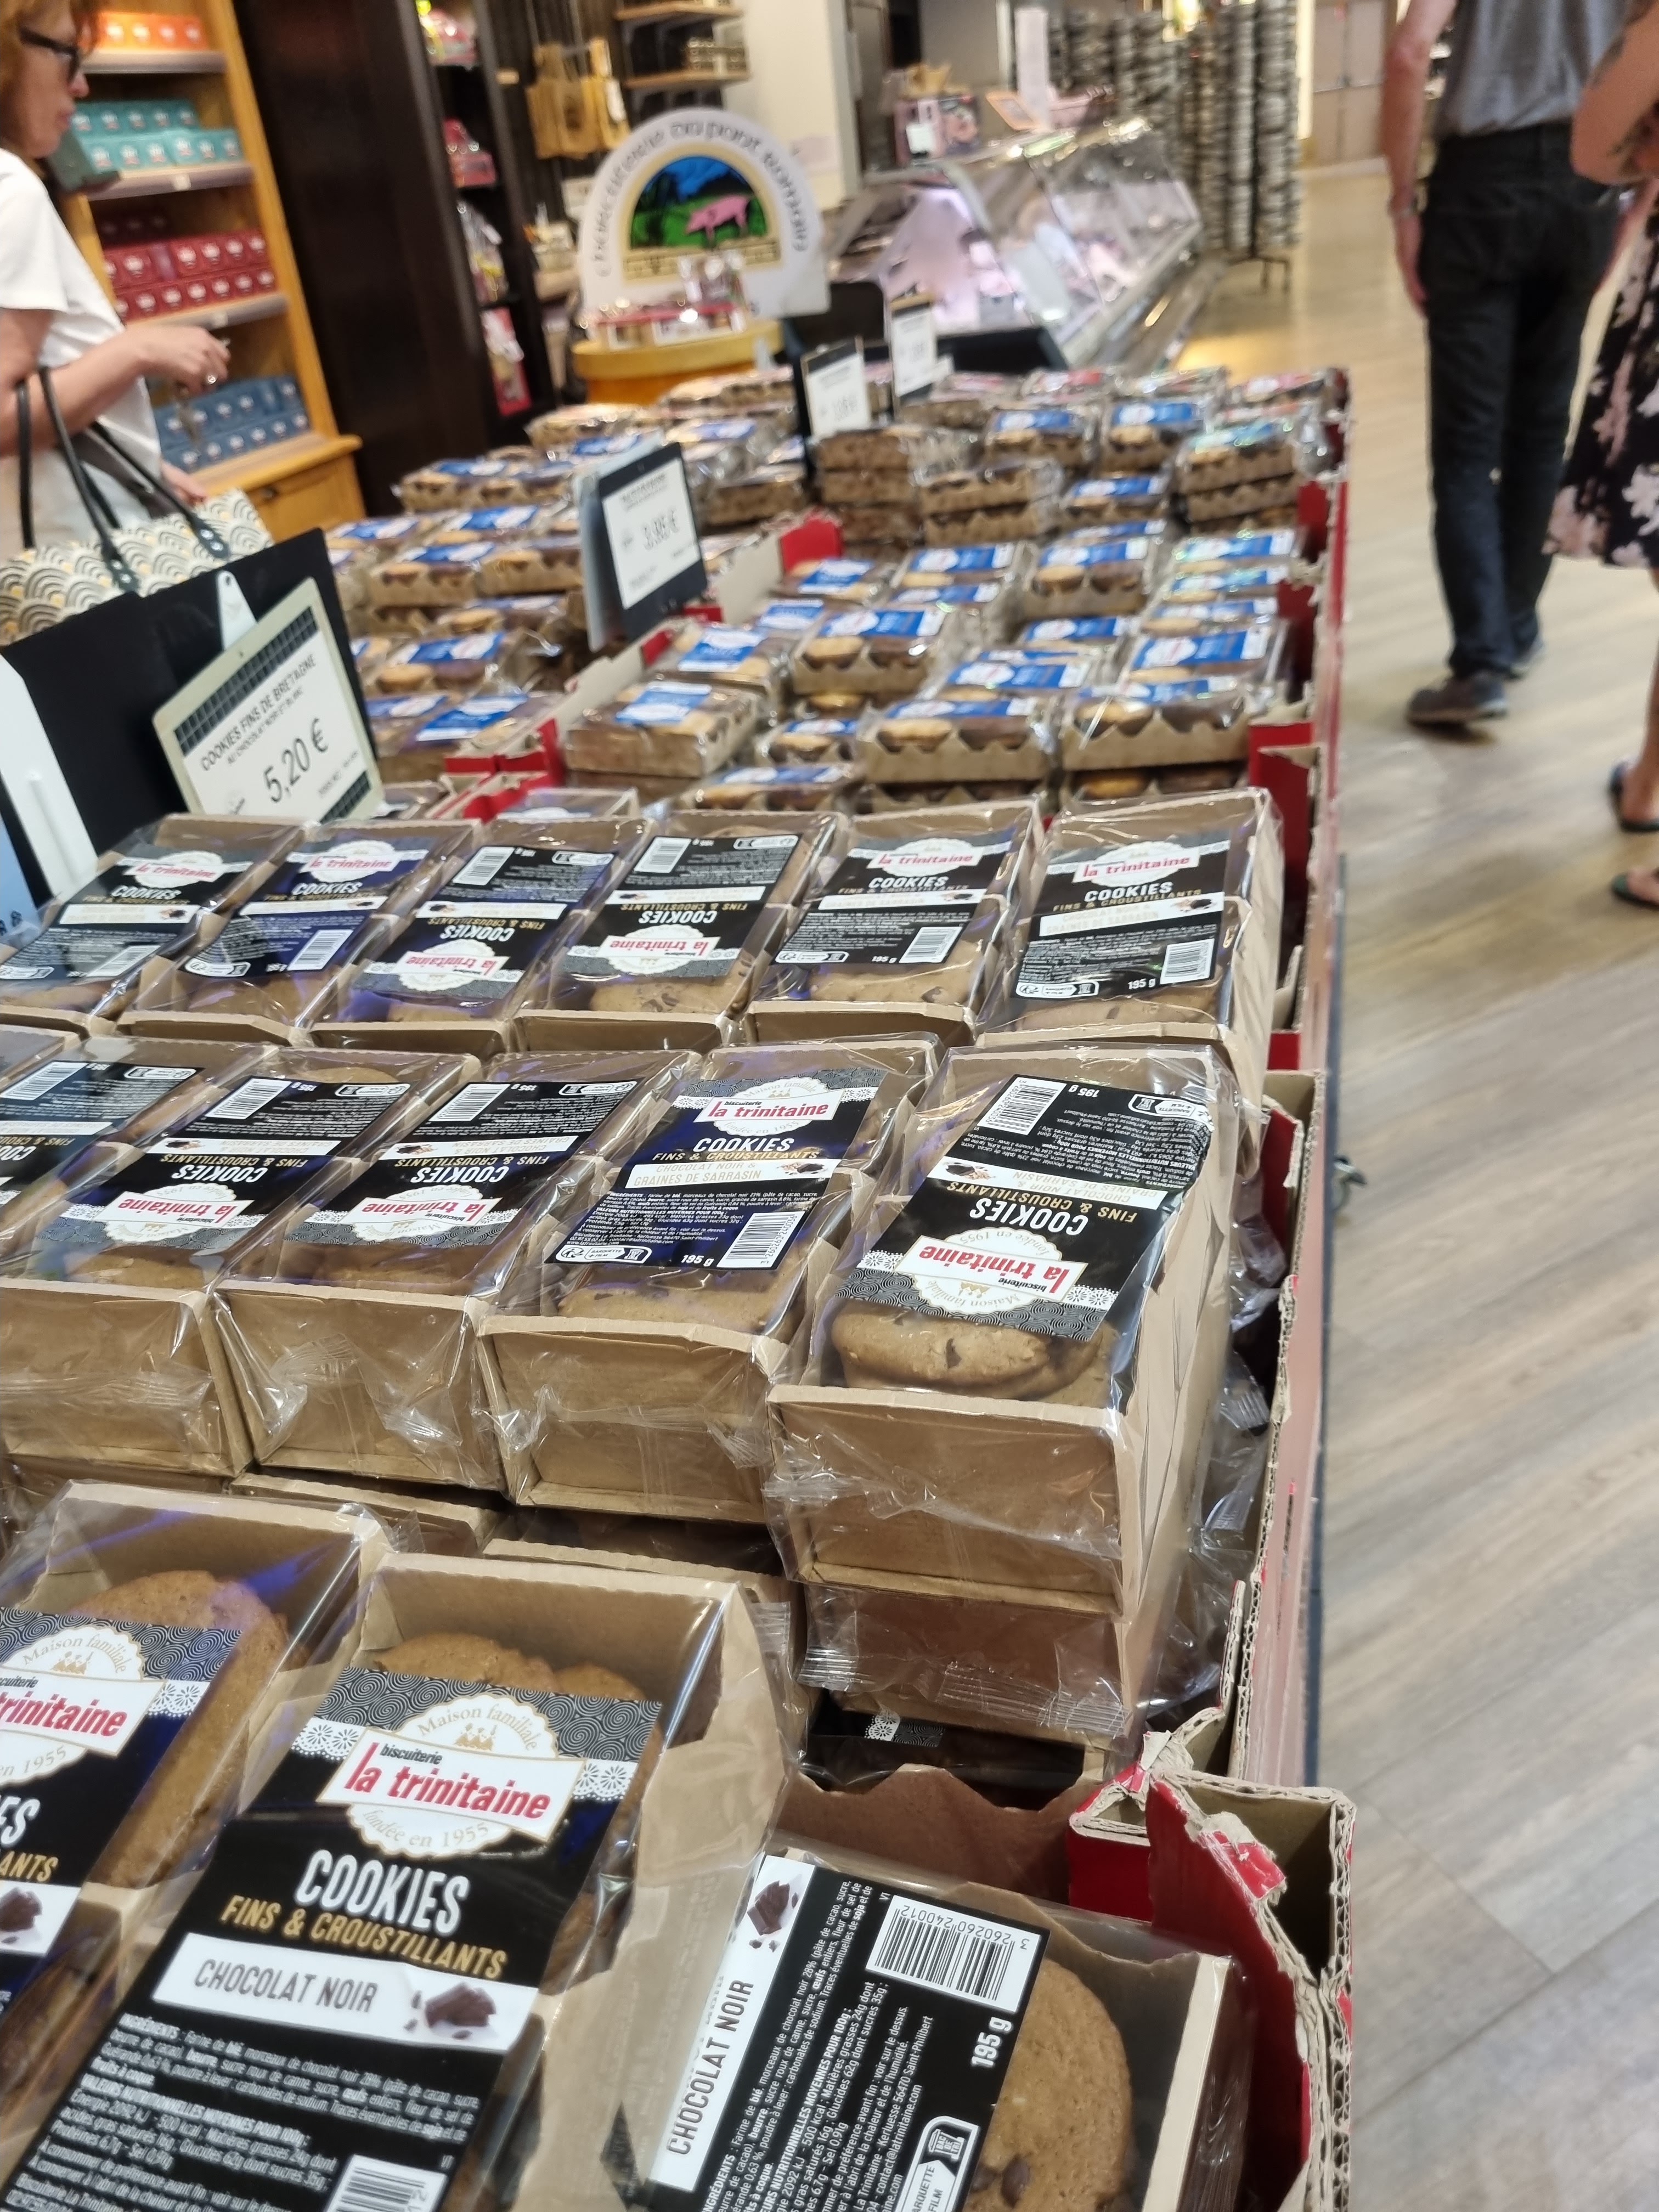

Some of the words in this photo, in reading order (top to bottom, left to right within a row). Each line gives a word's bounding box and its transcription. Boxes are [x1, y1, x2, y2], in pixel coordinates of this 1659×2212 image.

[201, 725, 242, 771] COOKIES
[240, 706, 262, 732] FINS
[258, 694, 274, 714] DE
[263, 737, 311, 803] 5,20
[311, 717, 329, 753] €
[327, 856, 391, 869] trinitaine
[878, 854, 892, 866] la
[898, 853, 973, 865] trinitaine
[1083, 865, 1098, 878] la
[1105, 856, 1190, 875] trinitaine
[111, 884, 182, 900] COOKIES
[292, 882, 363, 896] COOKIES
[868, 876, 949, 889] COOKIES
[1084, 881, 1173, 903] COOKIES
[722, 902, 748, 911] FINS
[638, 910, 718, 924] COOKIES
[440, 924, 516, 942] COOKIES
[610, 939, 687, 951] trinitaine
[692, 939, 709, 957] la
[406, 955, 478, 969] trinitaine
[482, 959, 498, 977] la
[1127, 977, 1146, 991] 195
[1147, 976, 1156, 989] g
[1068, 1084, 1078, 1093] g
[1077, 1087, 1100, 1098] 195
[708, 1101, 727, 1118] la
[733, 1103, 830, 1118] trinitaine
[773, 1120, 799, 1133] 1955
[692, 1138, 795, 1153] COOKIES
[161, 1154, 262, 1166] CROUSTILLANTS
[275, 1158, 309, 1168] FINS
[394, 1156, 498, 1168] CROUSTILLANTS
[516, 1156, 549, 1165] FINS
[652, 1153, 686, 1161] FINS
[689, 1152, 702, 1160] &
[706, 1151, 820, 1160] CROUSTILLANTS
[172, 1164, 269, 1183] COOKIES
[410, 1166, 510, 1183] COOKIES
[656, 1162, 714, 1173] CHOCOLAT
[716, 1161, 744, 1170] NOIR
[634, 1172, 684, 1187] GRAINES
[684, 1172, 699, 1183] DE
[702, 1170, 762, 1181] SARRASIN
[946, 1181, 1072, 1210] CROUSTILLANTS
[118, 1198, 213, 1217] trinitaine
[216, 1204, 237, 1224] la
[362, 1202, 460, 1217] trinitaine
[463, 1203, 486, 1222] la
[969, 1197, 1090, 1236] COOKIES
[1079, 1201, 1093, 1214] &
[1097, 1207, 1138, 1223] FINS
[959, 1231, 990, 1245] 1955
[680, 1255, 706, 1264] 195
[704, 1257, 714, 1267] g
[919, 1245, 1036, 1279] trinitaine
[998, 1277, 1047, 1293] biscuiterie
[1043, 1265, 1070, 1294] la
[22, 1637, 83, 1666] Maison
[87, 1632, 128, 1675] familiale
[0, 1676, 39, 1689] cuiterie
[417, 1706, 482, 1737] Maison
[486, 1702, 539, 1753] familiale
[23, 1744, 67, 1774] 1955
[379, 1743, 443, 1767] biscuiterie
[343, 1741, 383, 1794] la
[386, 1765, 552, 1820] trinitaine
[362, 1809, 404, 1847] fondée
[409, 1835, 432, 1848] en
[442, 1822, 489, 1849] 1955
[294, 1849, 470, 1937] COOKIES
[836, 1881, 851, 1901] sucre,
[851, 1883, 861, 1892] de
[847, 1894, 857, 1905] sel
[826, 1904, 842, 1926] cacao,
[840, 1908, 851, 1917] de
[900, 1905, 953, 1929] 240012
[221, 1894, 281, 1931] FINS
[283, 1909, 307, 1939] &
[310, 1911, 509, 1980] CROUSTILLANTS
[820, 1927, 831, 1937] de
[831, 1918, 846, 1937] fleur
[957, 1920, 1012, 1945] 260260
[811, 1939, 826, 1958] (pâte
[821, 1940, 839, 1967] entiers,
[1019, 1938, 1030, 1950] 3
[802, 1961, 817, 1978] 28%
[194, 1958, 316, 2005] CHOCOLAT
[315, 1977, 379, 2013] NOIR
[797, 1979, 809, 1996] noir
[782, 1997, 802, 2031] chocolat
[802, 1993, 817, 2016] sucre,
[776, 2033, 787, 2044] de
[790, 2019, 807, 2044] canne,
[783, 2046, 794, 2057] de
[902, 2016, 933, 2076] Saint-Philibert
[970, 2032, 1001, 2068] 195
[989, 2016, 1013, 2032] g
[667, 2036, 730, 2155] CHOCOLAT
[714, 1979, 754, 2032] NOIR
[759, 2045, 782, 2085] morceaux
[775, 2059, 789, 2078] roux
[749, 2088, 765, 2103] blé,
[764, 2081, 780, 2103] sucre
[781, 2164, 803, 2197] 2092
[793, 2157, 805, 2169] kJ
[801, 2126, 817, 2146] 500
[810, 2104, 826, 2125] kcal
[820, 2058, 845, 2098] Matières
[839, 2022, 859, 2057] grasses
[849, 2004, 868, 2021] 24g
[859, 1982, 874, 2002] dont
[893, 2076, 911, 2103] 56470
[744, 2105, 756, 2116] de
[770, 2107, 811, 2190] NUTRITIONNELLES
[804, 2058, 831, 2107] MOYENNES
[823, 2034, 841, 2058] POUR
[833, 2013, 854, 2034] 100g
[731, 2119, 750, 2146] Farine
[748, 2108, 770, 2139] beurre,
[877, 2104, 901, 2147] Kerluesse
[876, 2084, 922, 2194] contact@latrinitaine.com
[736, 2143, 755, 2172] cacao),
[702, 2154, 735, 2212] NGRÉDIENTS
[729, 2176, 740, 2187] de
[857, 2153, 883, 2196] Trinitaine
[913, 2165, 936, 2212] ARQUETTE
[718, 2190, 734, 2212] eurre
[853, 2198, 866, 2211] La
